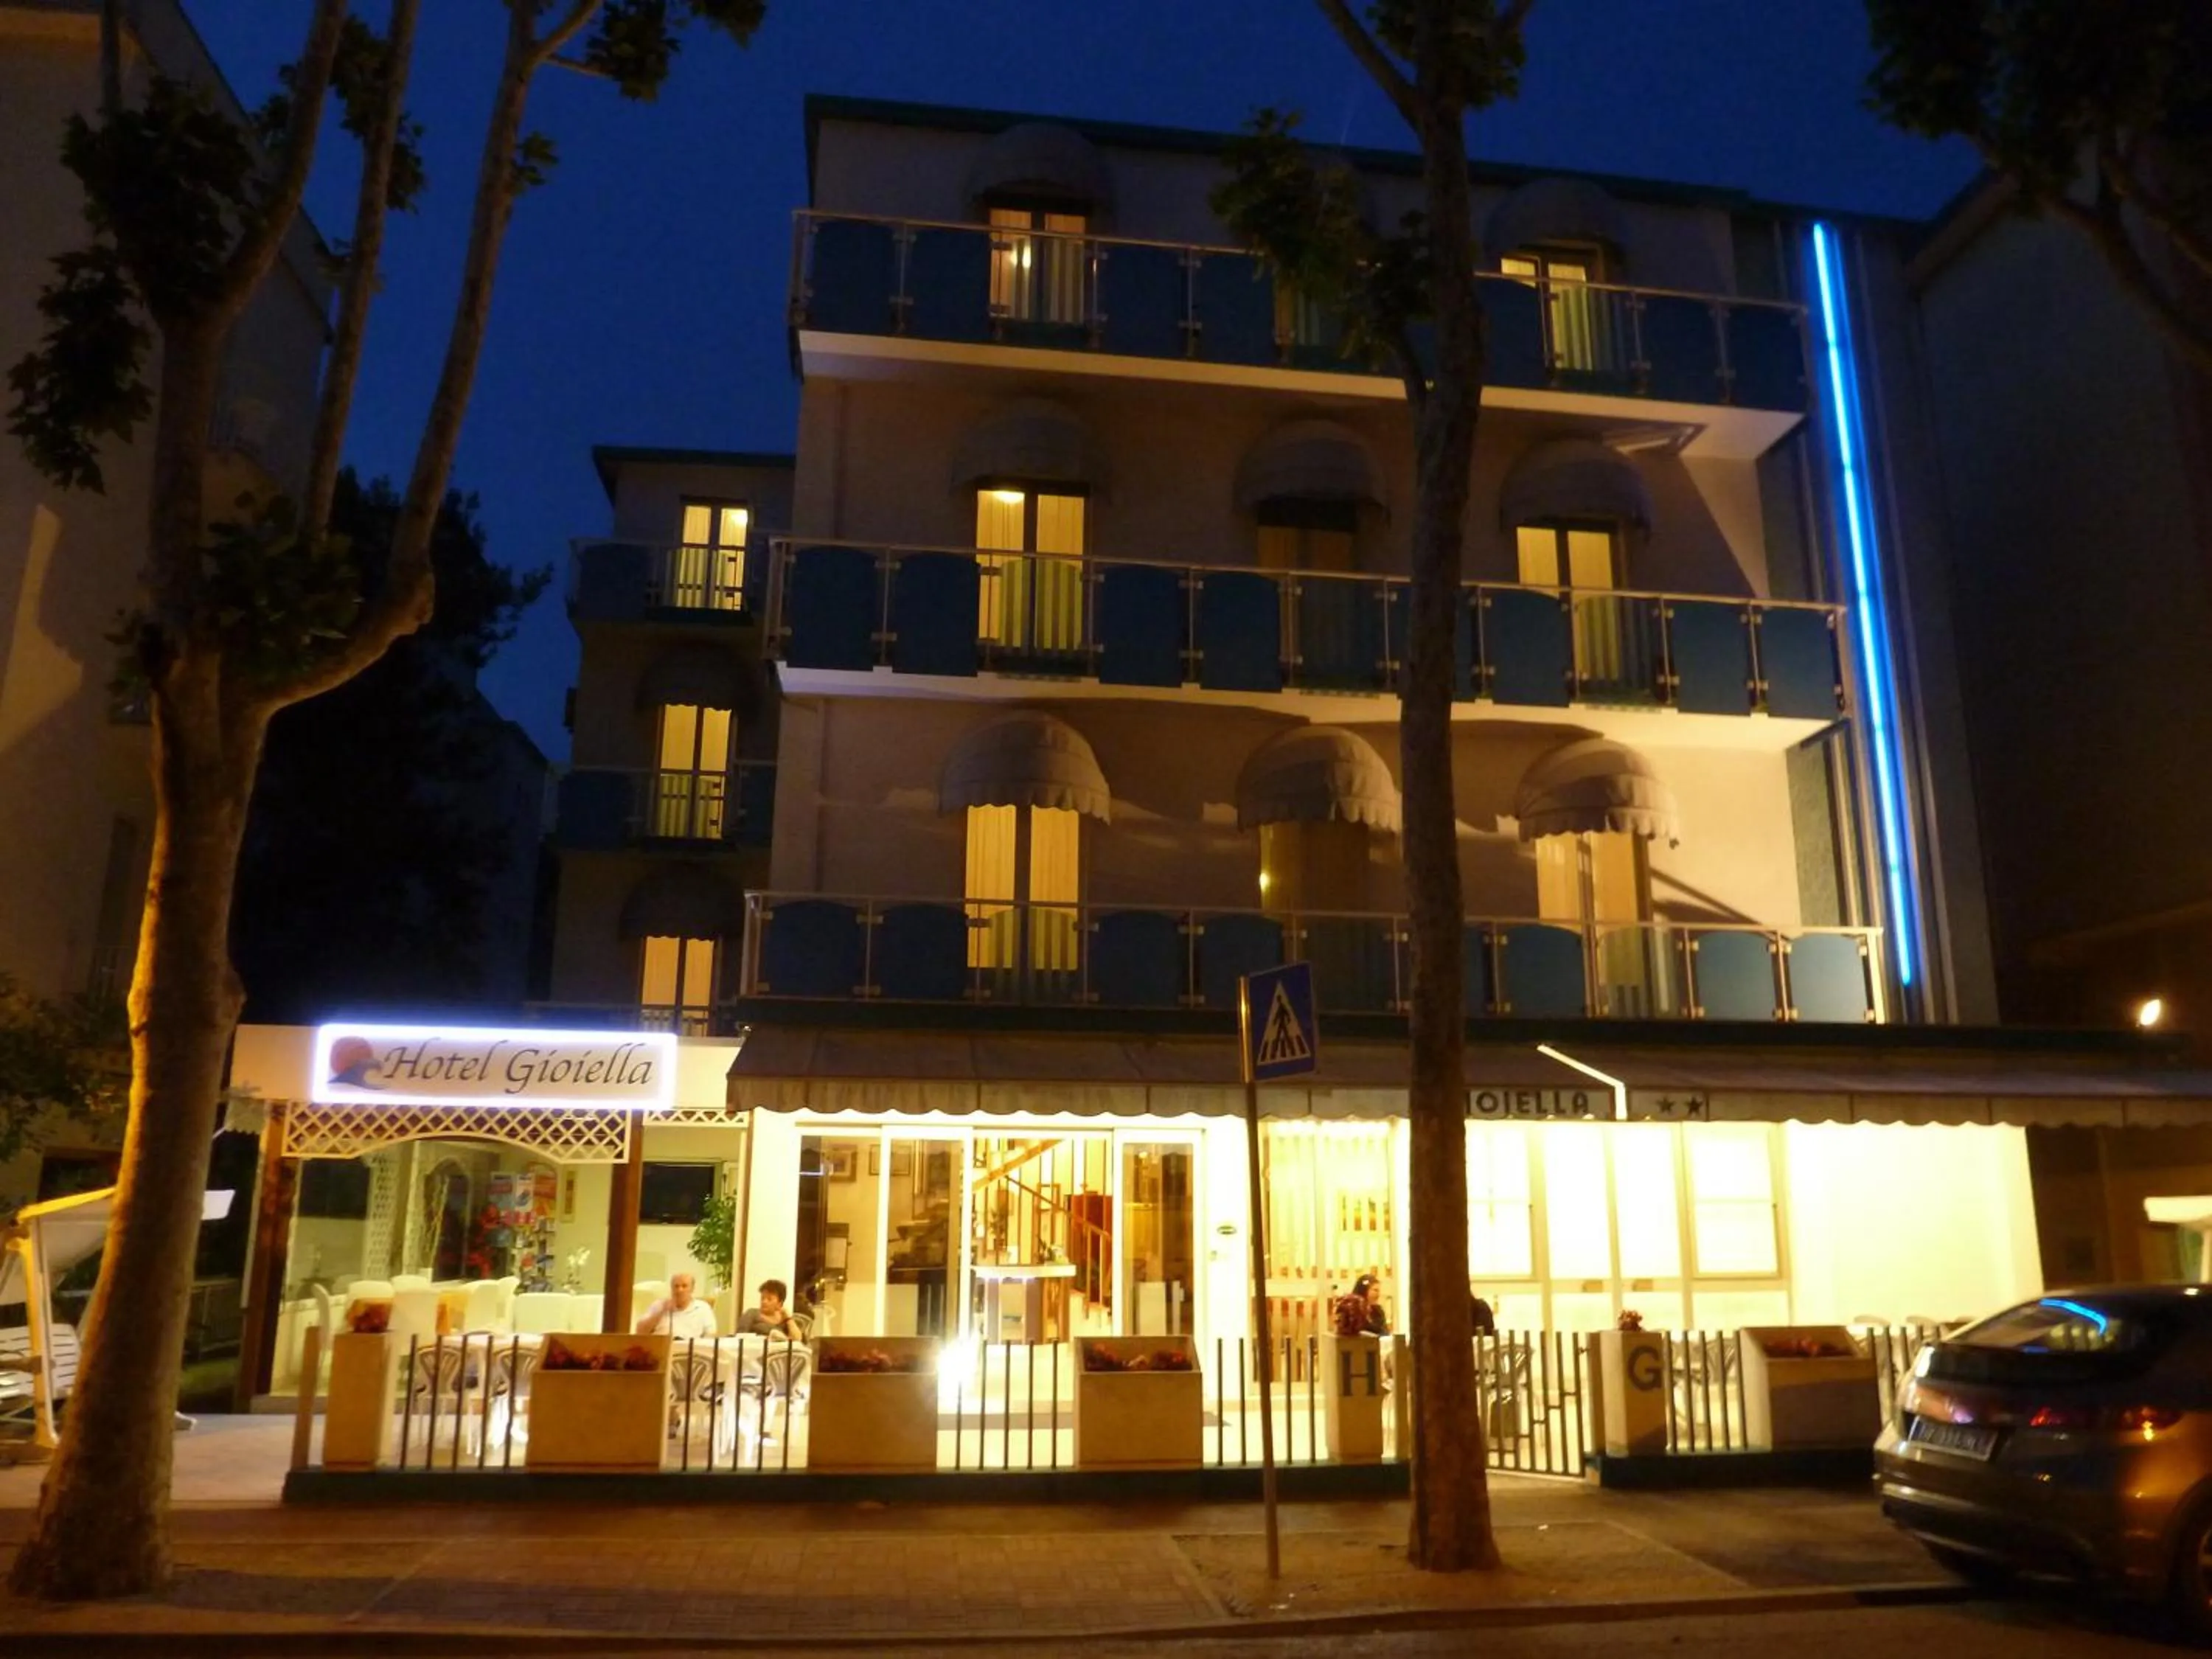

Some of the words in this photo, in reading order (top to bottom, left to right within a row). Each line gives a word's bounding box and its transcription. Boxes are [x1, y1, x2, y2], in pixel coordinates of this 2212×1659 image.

[383, 1037, 508, 1082] Hotel
[504, 1042, 653, 1095] Gioiella
[1465, 1090, 1589, 1115] IOIELLA
[1340, 1350, 1378, 1397] H
[1627, 1345, 1663, 1392] G
